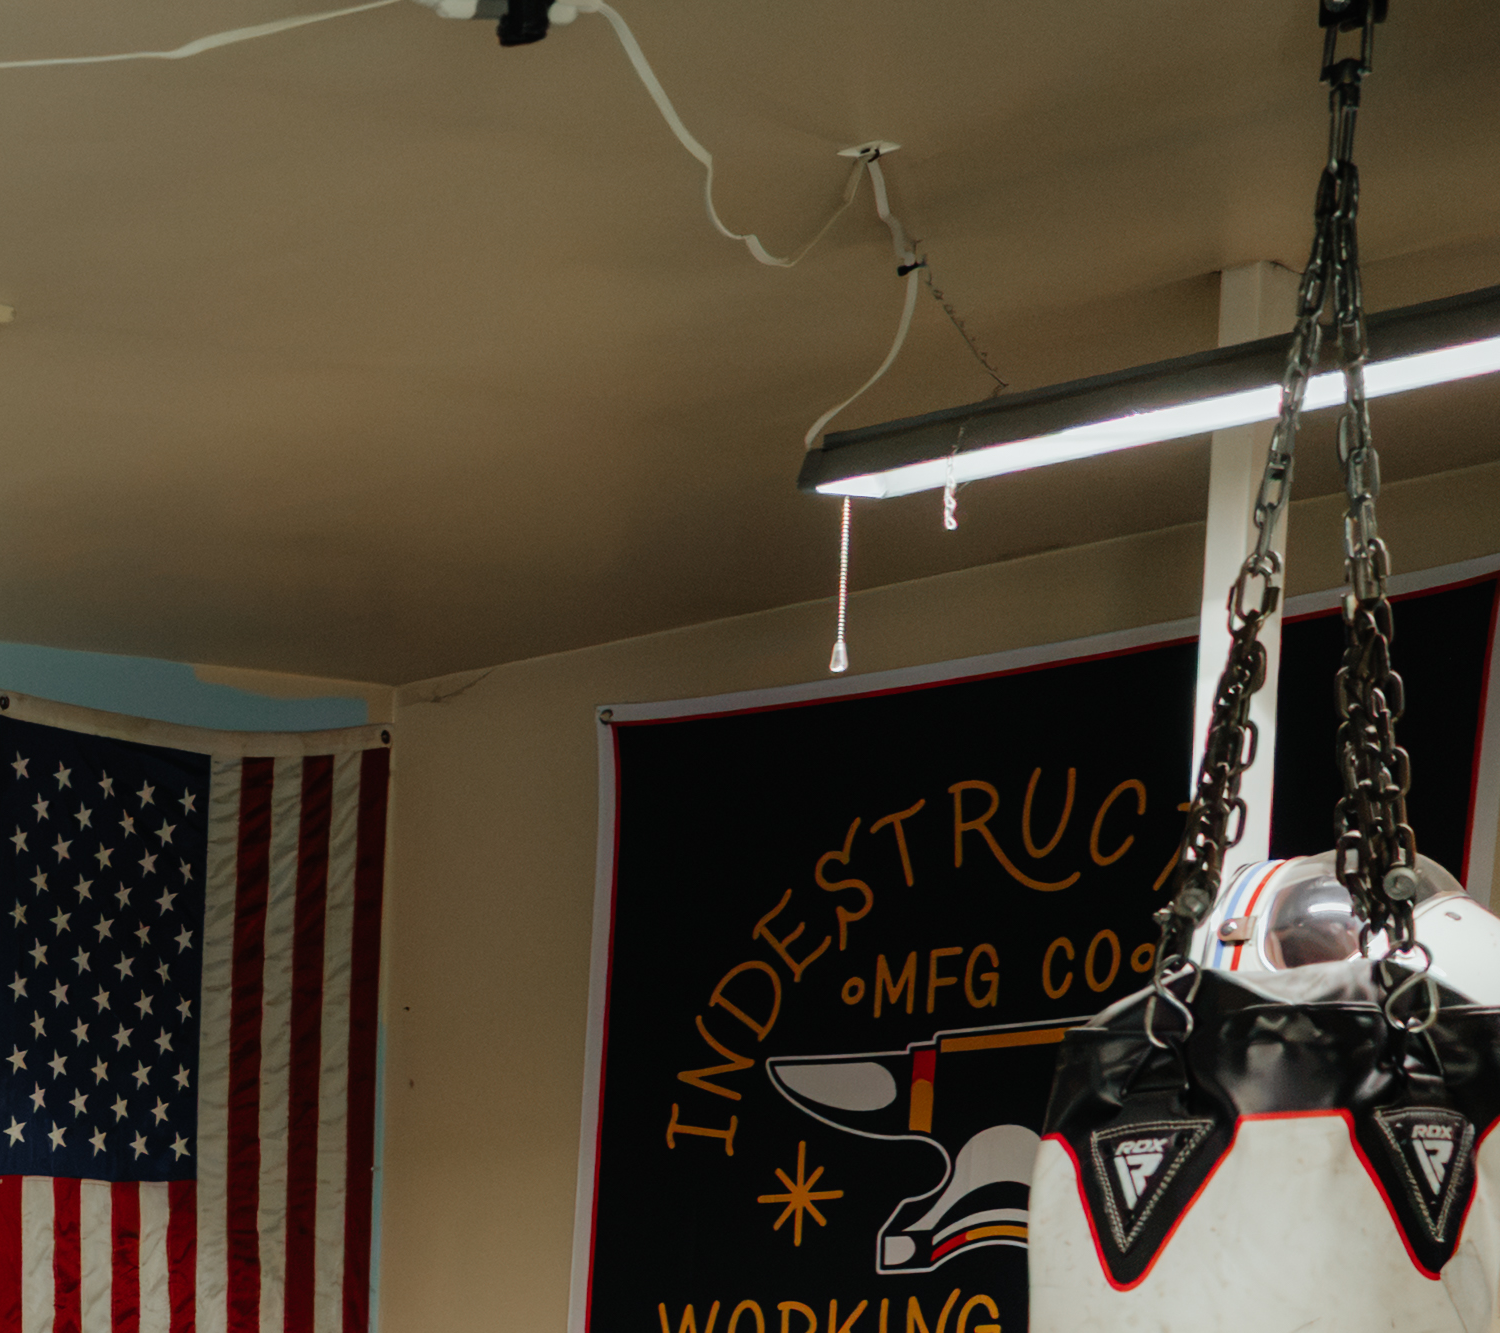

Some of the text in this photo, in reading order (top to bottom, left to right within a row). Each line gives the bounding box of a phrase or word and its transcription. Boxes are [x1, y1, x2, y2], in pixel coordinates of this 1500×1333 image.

[874, 930, 1121, 1018] MFG CO
[1411, 1123, 1453, 1139] RDX
[1114, 1137, 1168, 1155] RDX
